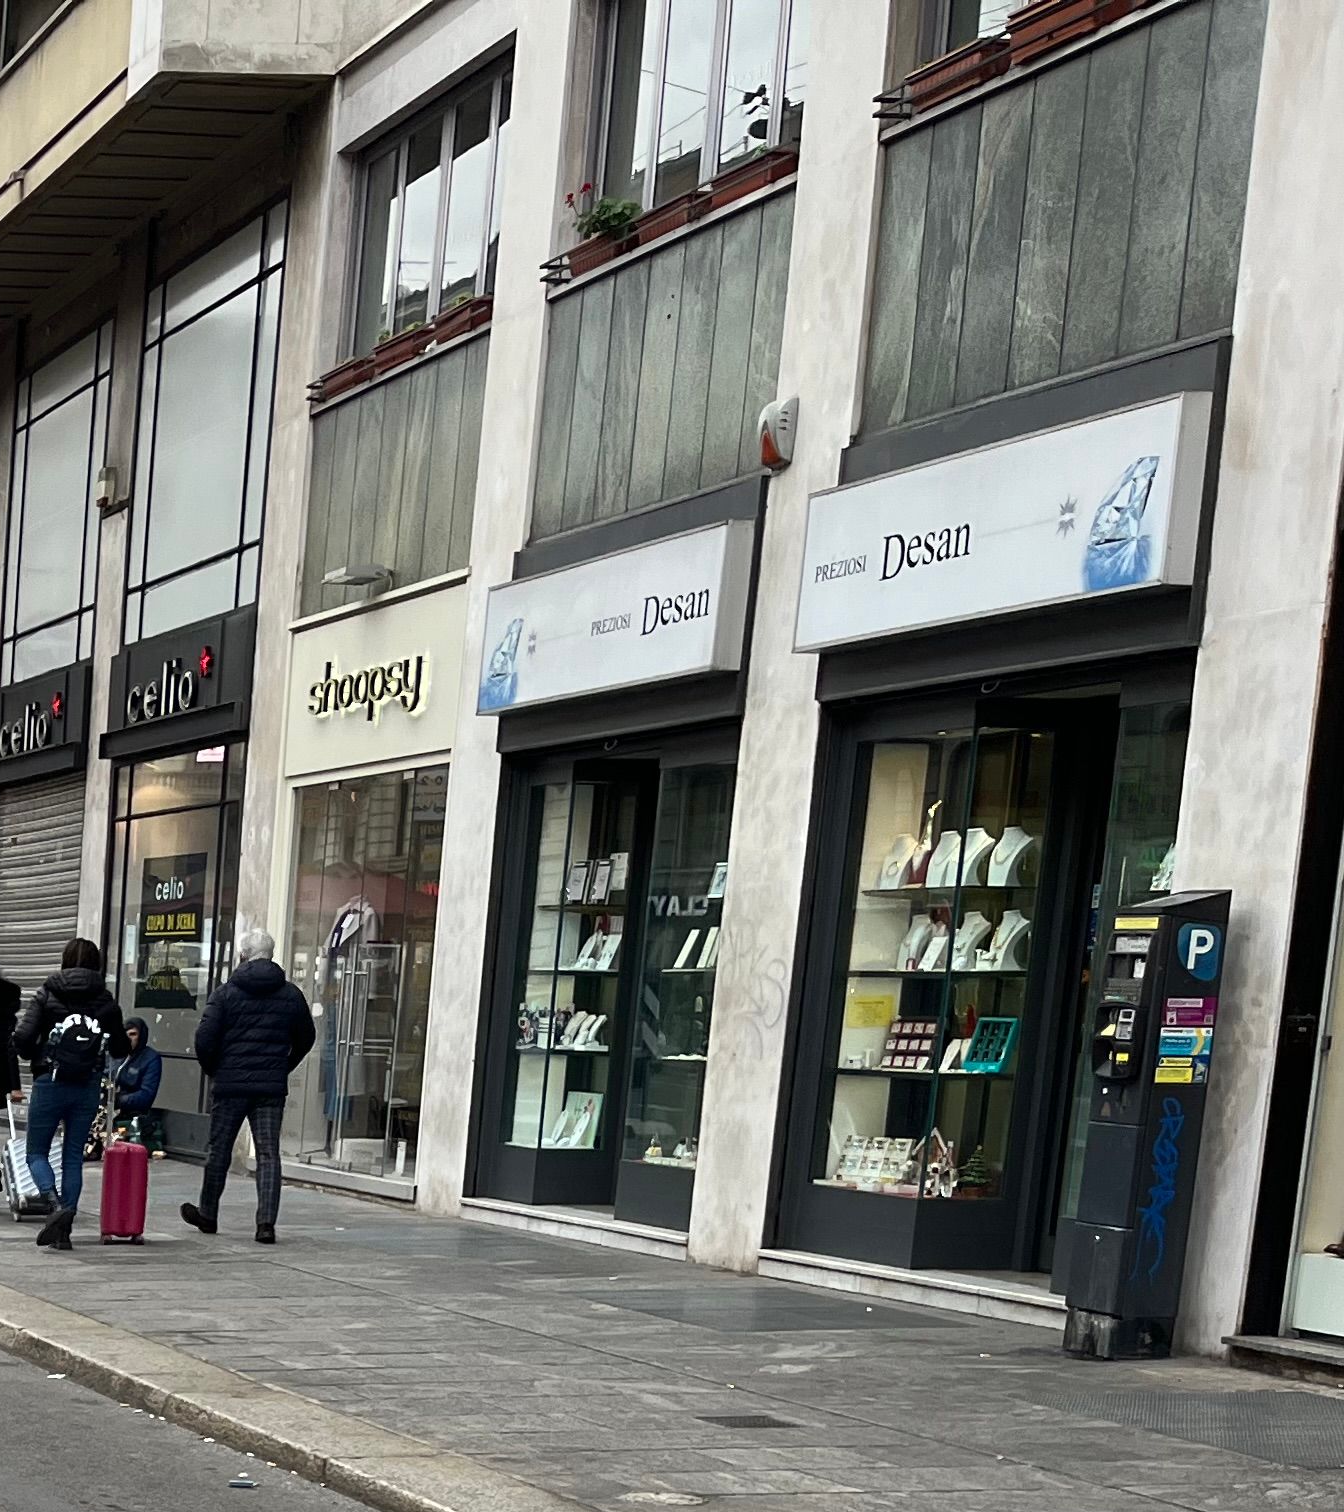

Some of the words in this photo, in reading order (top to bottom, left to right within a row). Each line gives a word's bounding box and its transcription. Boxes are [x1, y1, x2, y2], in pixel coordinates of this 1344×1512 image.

[814, 554, 868, 584] PREZIOSI
[878, 522, 972, 581] Desan
[590, 612, 632, 638] PREZIOSI
[639, 587, 710, 636] Desan
[127, 658, 194, 724] celio
[308, 655, 424, 722] shoopsy
[155, 876, 184, 901] celio
[1186, 928, 1215, 970] P
